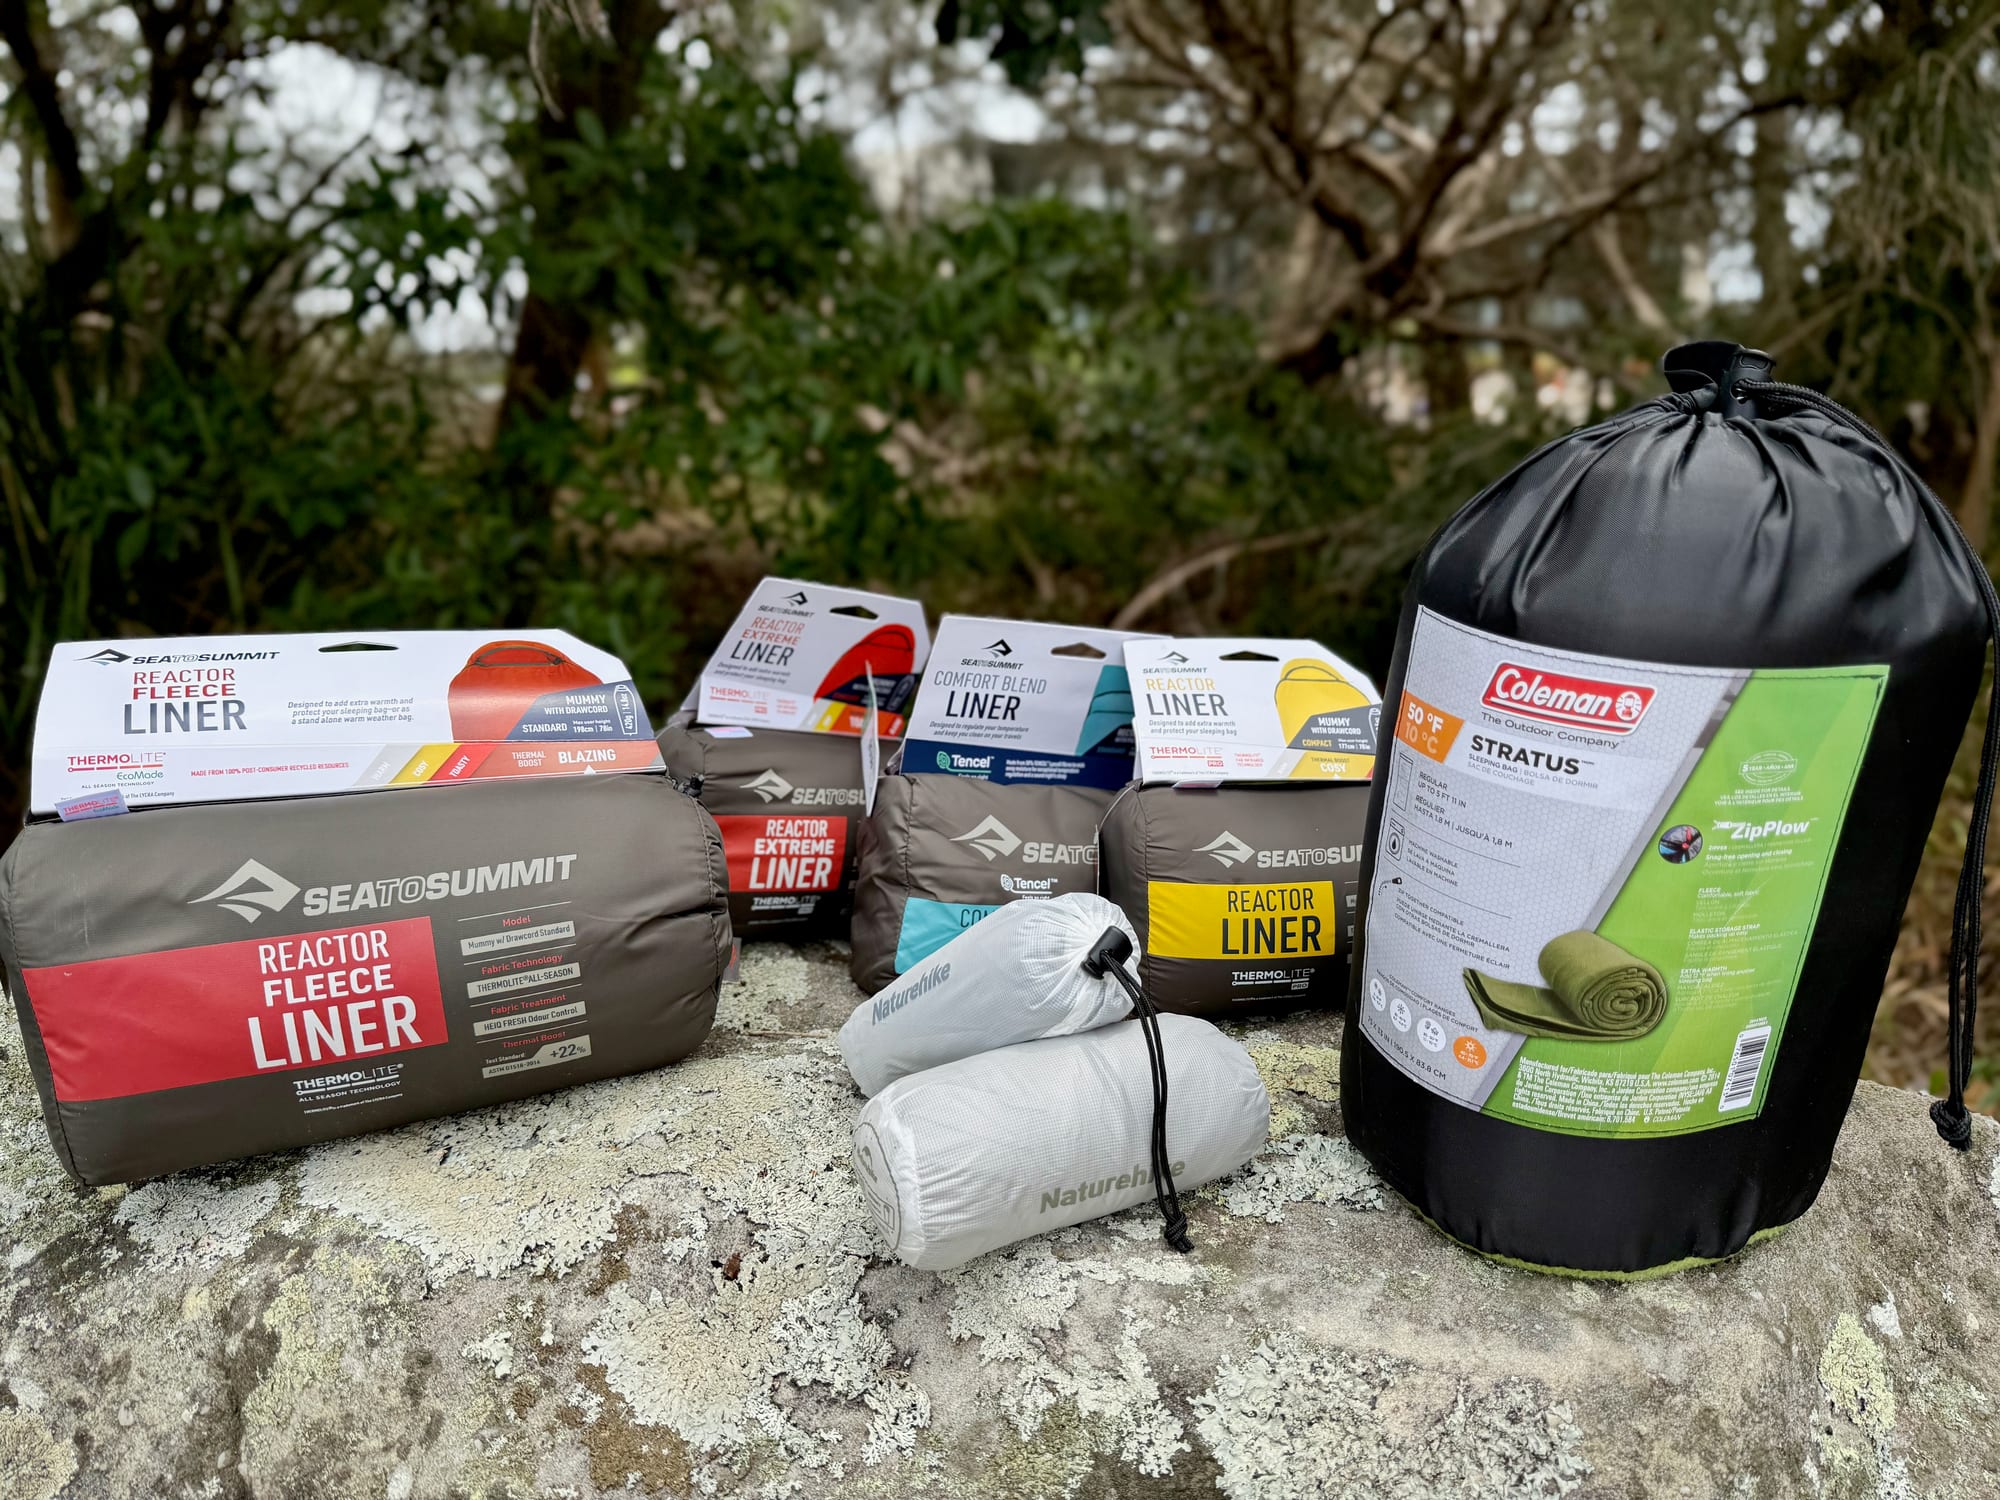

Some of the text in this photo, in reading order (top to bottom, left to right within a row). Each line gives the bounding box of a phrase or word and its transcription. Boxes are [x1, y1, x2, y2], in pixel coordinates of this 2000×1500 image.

[751, 616, 805, 635] REACTOR
[741, 629, 800, 646] EXTREME
[132, 651, 280, 665] SEATOSUMMIT
[730, 640, 794, 667] LINER
[133, 667, 236, 686] REACTOR
[933, 670, 1048, 695] COMFORT BLEND
[1145, 677, 1216, 691] REACTOR
[132, 683, 237, 700] FLEECE
[565, 694, 606, 706] MUMMY
[1495, 667, 1613, 718] Coleman
[288, 697, 414, 710] Designed to add extra warmth and
[292, 708, 320, 718] protect
[321, 708, 340, 717] your
[340, 706, 372, 716] sleeping
[544, 705, 609, 715] WITH DRAWCORD
[945, 690, 1021, 721] LINER
[1147, 692, 1229, 717] LINER
[1407, 701, 1423, 725] 50
[123, 699, 248, 735] LINER
[298, 717, 320, 725] stand
[320, 716, 342, 724] alone
[366, 714, 397, 723] weather
[398, 714, 414, 724] bag.
[1318, 717, 1350, 727] MUMMY
[1481, 711, 1501, 725] The
[1504, 718, 1554, 738] Outdoor
[522, 722, 568, 733] STANDARD
[572, 725, 594, 733] 198cm
[929, 720, 1029, 734] Designed regulate your temperature
[1200, 728, 1225, 736] sleeping
[1327, 727, 1361, 735] DRAWCORD
[1404, 723, 1418, 741] 10
[1302, 739, 1332, 747] COMPACT
[511, 750, 547, 760] THERMAL
[518, 758, 542, 768] BOOST
[557, 748, 617, 765] BLAZING
[190, 769, 207, 777] MADE
[241, 765, 289, 775] POST-CONSUMER
[412, 759, 429, 777] COSY
[448, 754, 471, 777] TOASTY
[1320, 763, 1346, 773] COSY
[1467, 762, 1535, 786] SAC DE COUCHAGE
[1468, 753, 1550, 782] SLEEPING BAG BOLSA
[116, 770, 164, 781] EcoMade
[1419, 771, 1448, 791] REGULAR
[791, 787, 867, 805] SEATOSU
[1417, 781, 1426, 790] UP
[1427, 785, 1436, 795] TO
[1441, 792, 1450, 802] FT
[1458, 799, 1467, 809] IN
[765, 819, 829, 838] REACTOR
[1414, 804, 1434, 820] HASTA
[1444, 818, 1451, 828] M
[1455, 824, 1490, 842] JUSQU'À
[1504, 839, 1513, 849] M
[1731, 819, 1810, 843] ZipPlow
[754, 838, 836, 856] EXTREME
[1256, 844, 1363, 869] SEATOSU
[748, 857, 833, 889] LINER
[303, 853, 577, 917] SEATOSUMMIT
[1227, 888, 1315, 913] REACTOR
[502, 915, 531, 927] Model
[468, 925, 571, 950] Mummy Drawcord Standard
[1221, 915, 1322, 955] LINER
[1450, 934, 1475, 948] DORMIR
[1466, 933, 1510, 953] CREMALLERA
[258, 929, 390, 975] REACTOR
[1449, 943, 1510, 970] FERMETURE ÉCLAIR
[481, 953, 563, 975] Fabric Technology
[262, 963, 395, 1008] FLEECE
[871, 961, 951, 1026] Naturehike
[490, 994, 567, 1015] Fabric Treatment
[502, 1016, 527, 1028] FRESH
[527, 1012, 550, 1024] Odour
[550, 1006, 578, 1020] Control
[247, 994, 423, 1070] LINER
[502, 1031, 567, 1049] Thermal Boost
[549, 1043, 587, 1059] +22%
[1433, 1069, 1447, 1080] CM
[315, 1090, 348, 1101] SEASON
[349, 1080, 401, 1095] TECHNOLOGY
[1039, 1160, 1185, 1214] Naturehe
